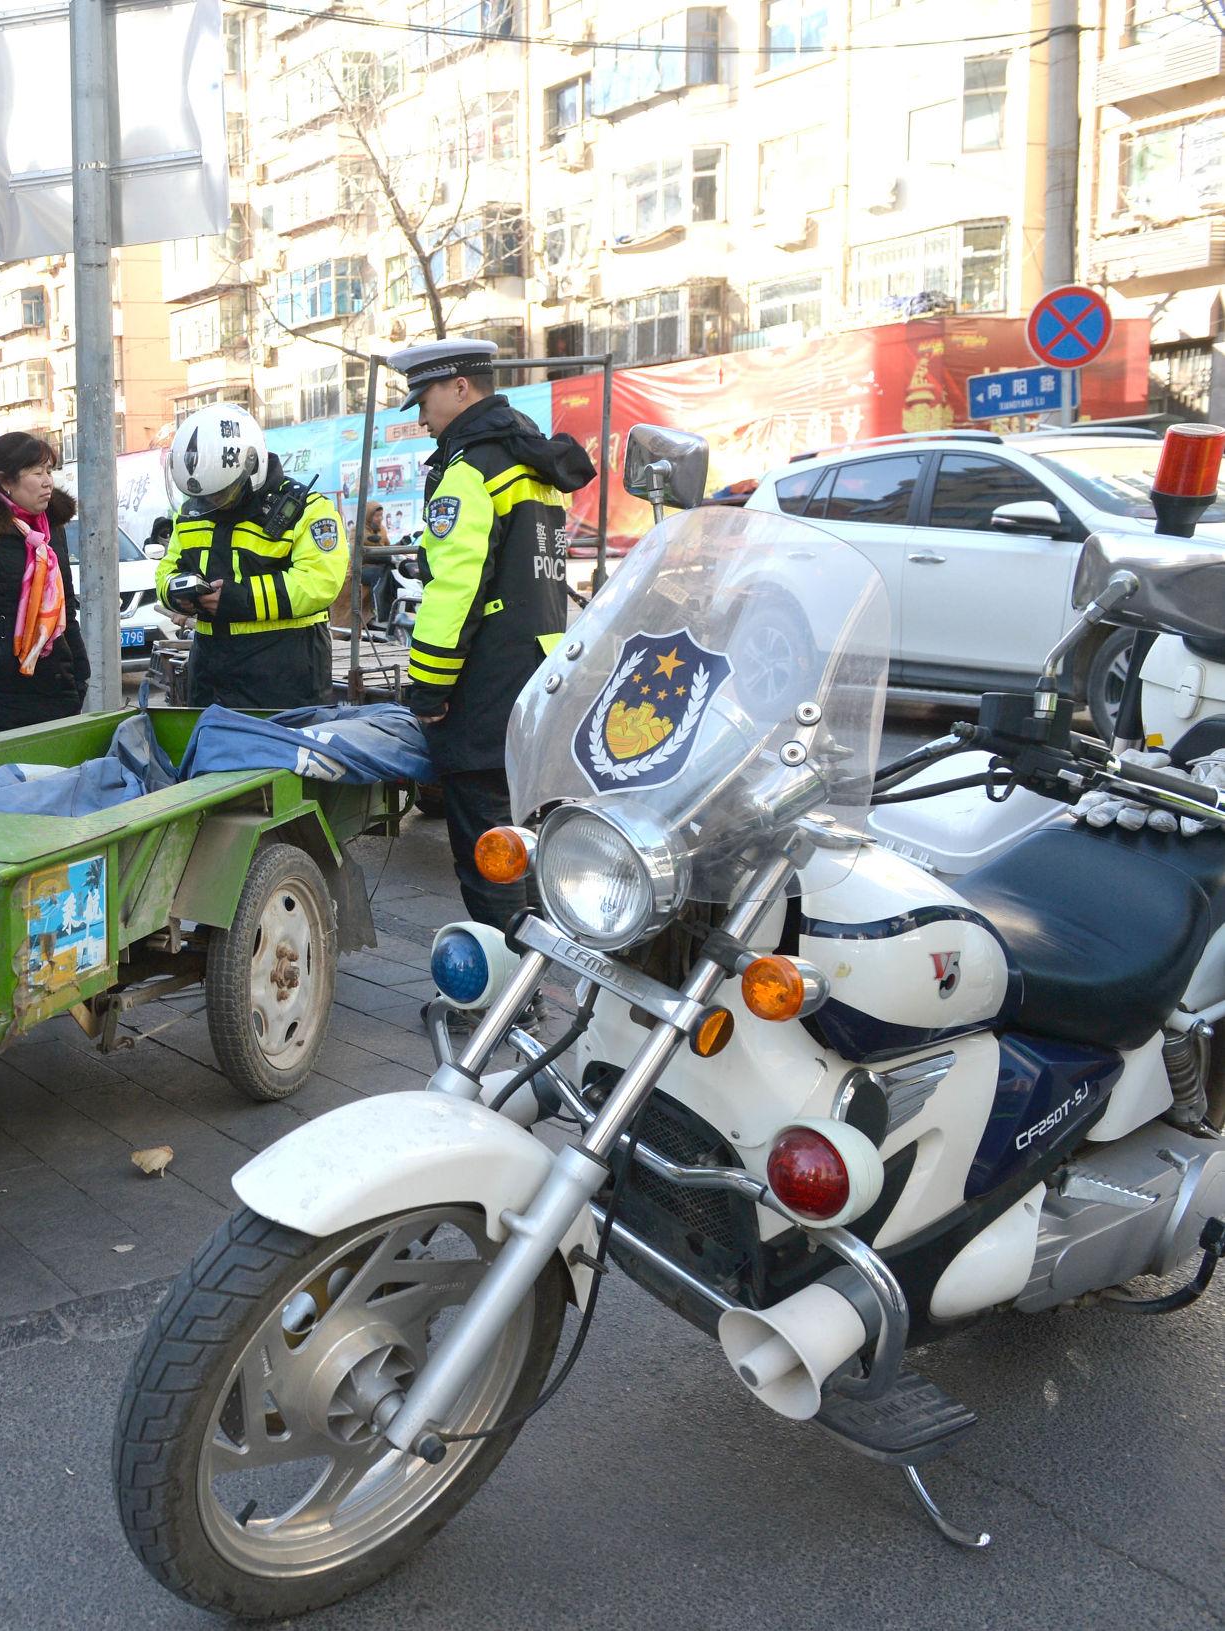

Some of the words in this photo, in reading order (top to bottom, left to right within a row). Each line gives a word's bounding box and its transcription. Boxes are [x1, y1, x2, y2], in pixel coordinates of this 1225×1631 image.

[988, 375, 1055, 400] 向阳路
[535, 521, 567, 556] 警察
[1015, 1081, 1089, 1151] CF250T-SJ
